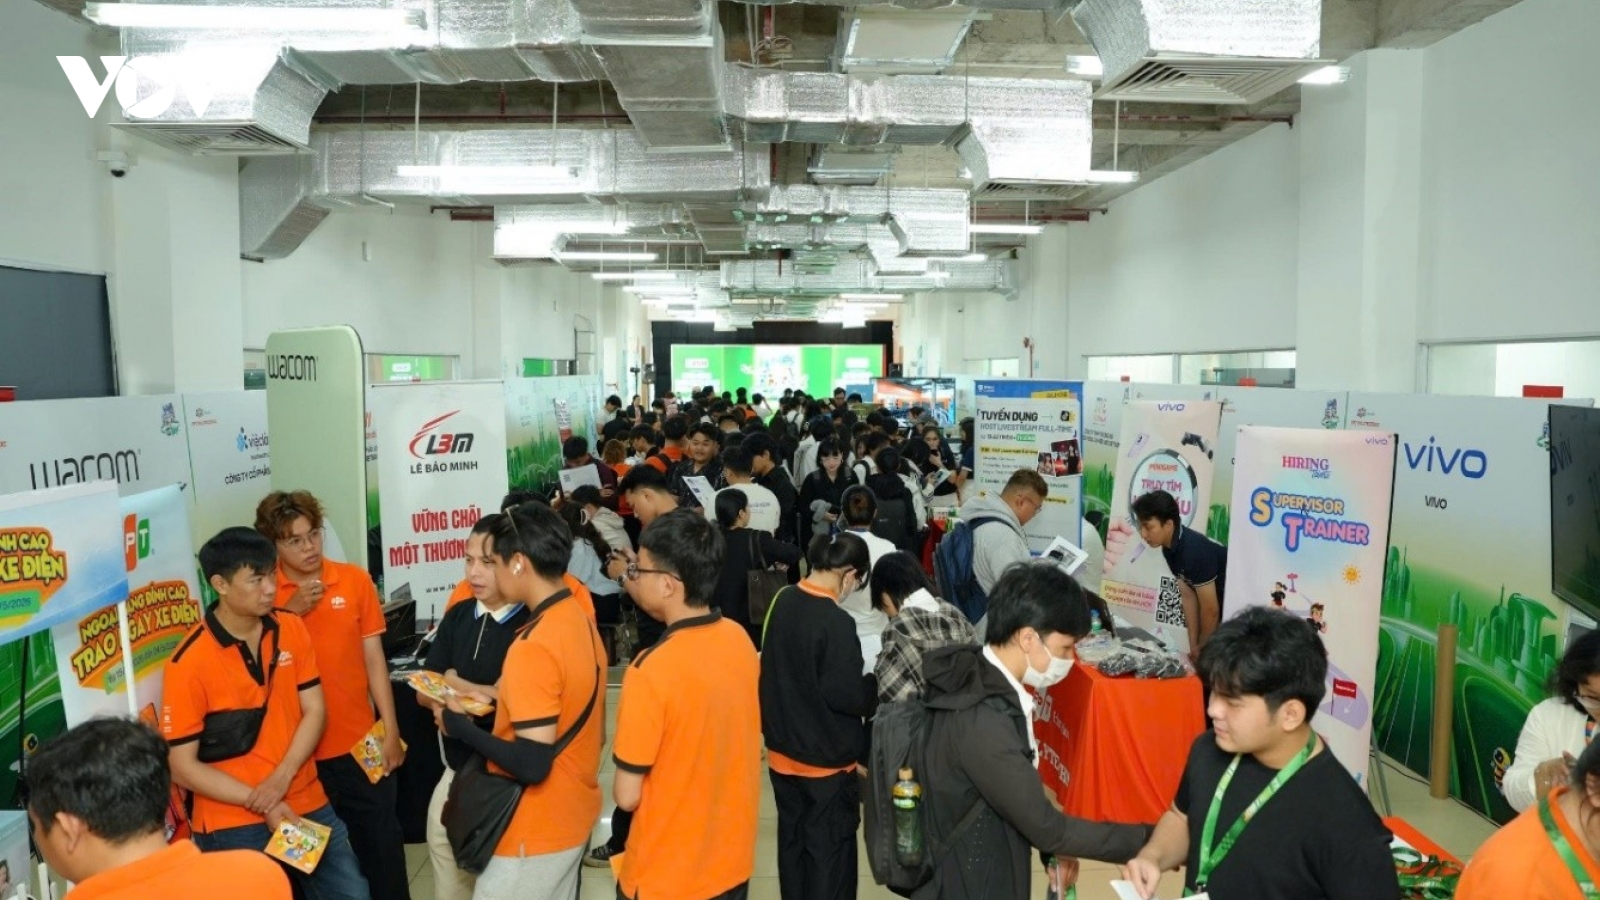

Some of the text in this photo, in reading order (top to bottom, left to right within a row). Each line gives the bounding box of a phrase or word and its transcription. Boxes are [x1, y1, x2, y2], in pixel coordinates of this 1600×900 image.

[266, 355, 316, 381] wacom
[981, 407, 1038, 424] TUYỂN DỤNG
[1157, 402, 1185, 411] vivo
[1365, 437, 1388, 446] vivo
[1282, 456, 1330, 471] HIRING
[1404, 436, 1487, 479] vivo
[410, 460, 478, 474] LÊ BẢO MINH
[1141, 478, 1182, 491] TRUY TÌM
[1250, 488, 1345, 526] SUPERVISOR
[411, 503, 448, 533] VỮNG
[0, 533, 50, 551] NH CAO
[1283, 514, 1369, 552] TRAINER
[389, 541, 419, 569] MỘT
[168, 584, 188, 600] CAO
[72, 631, 117, 680] TRAO
[128, 610, 153, 641] GAY
[153, 605, 171, 630] XE
